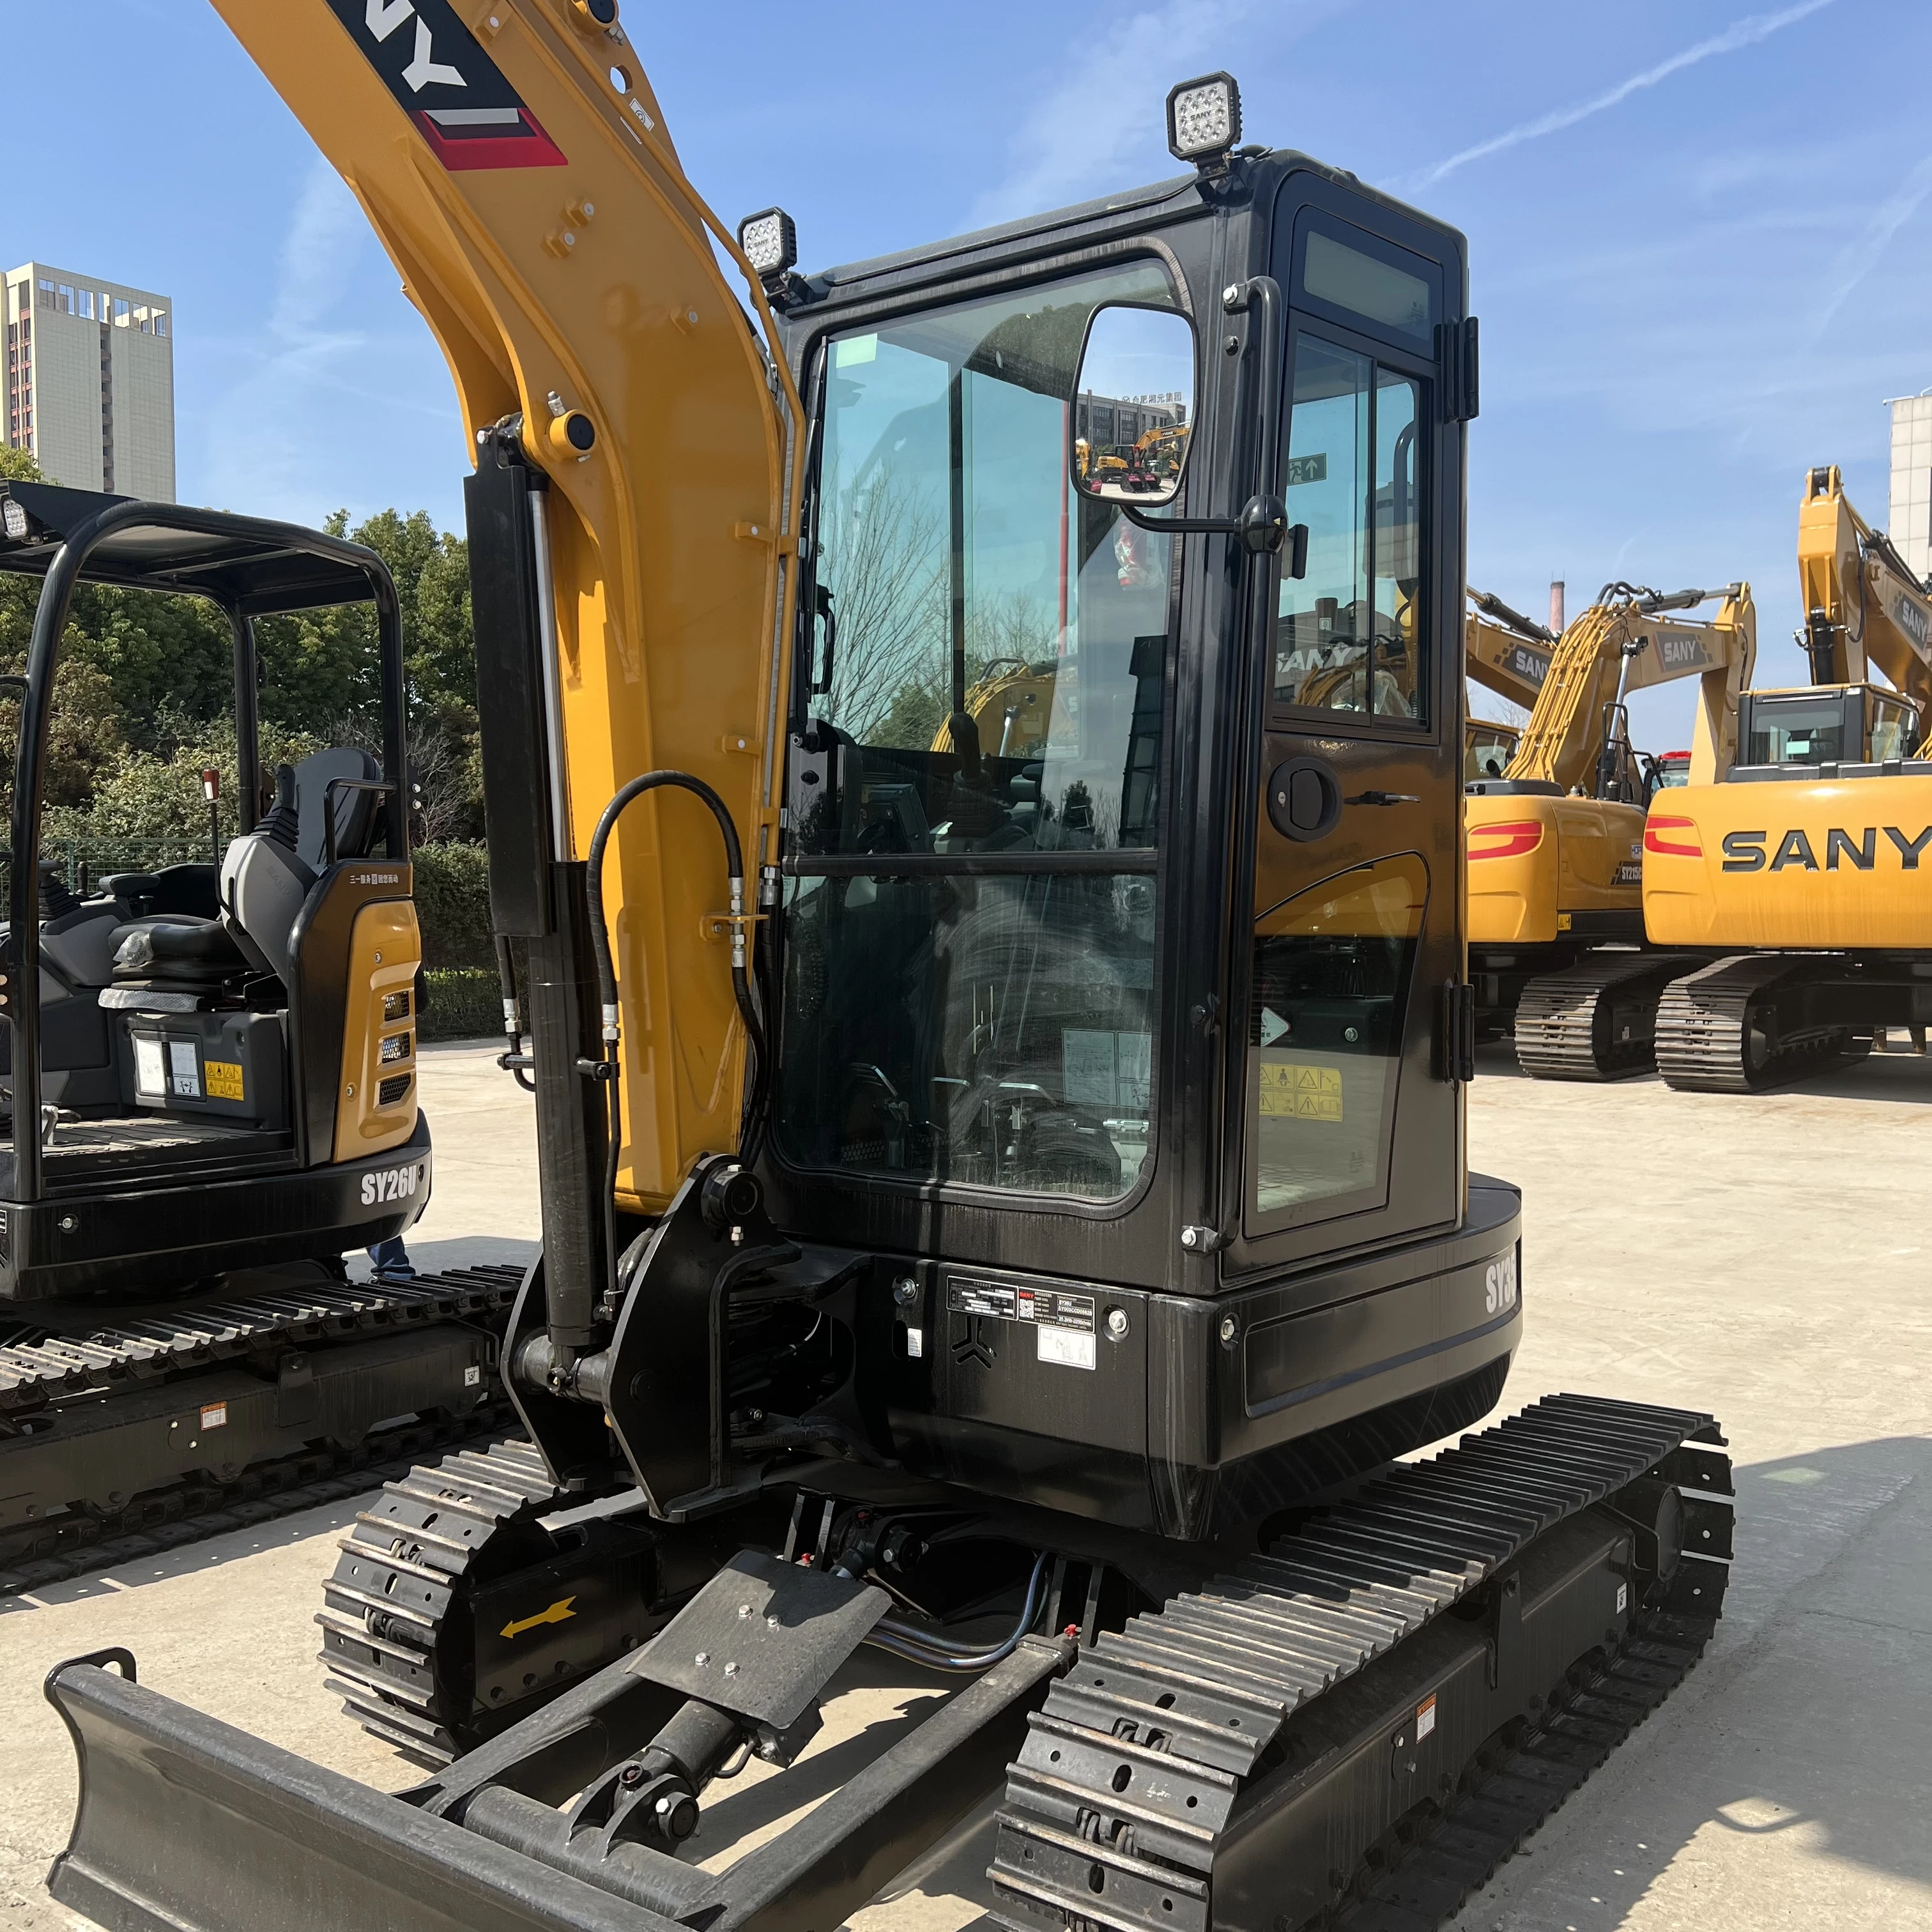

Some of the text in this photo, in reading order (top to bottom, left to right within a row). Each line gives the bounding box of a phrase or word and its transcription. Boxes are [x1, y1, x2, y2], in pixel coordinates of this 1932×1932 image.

[1190, 110, 1211, 121] SANY
[1903, 601, 1928, 643] SANY
[1664, 640, 1696, 663] SANY
[1722, 825, 1932, 873] SANY
[360, 1164, 417, 1206] SY26U
